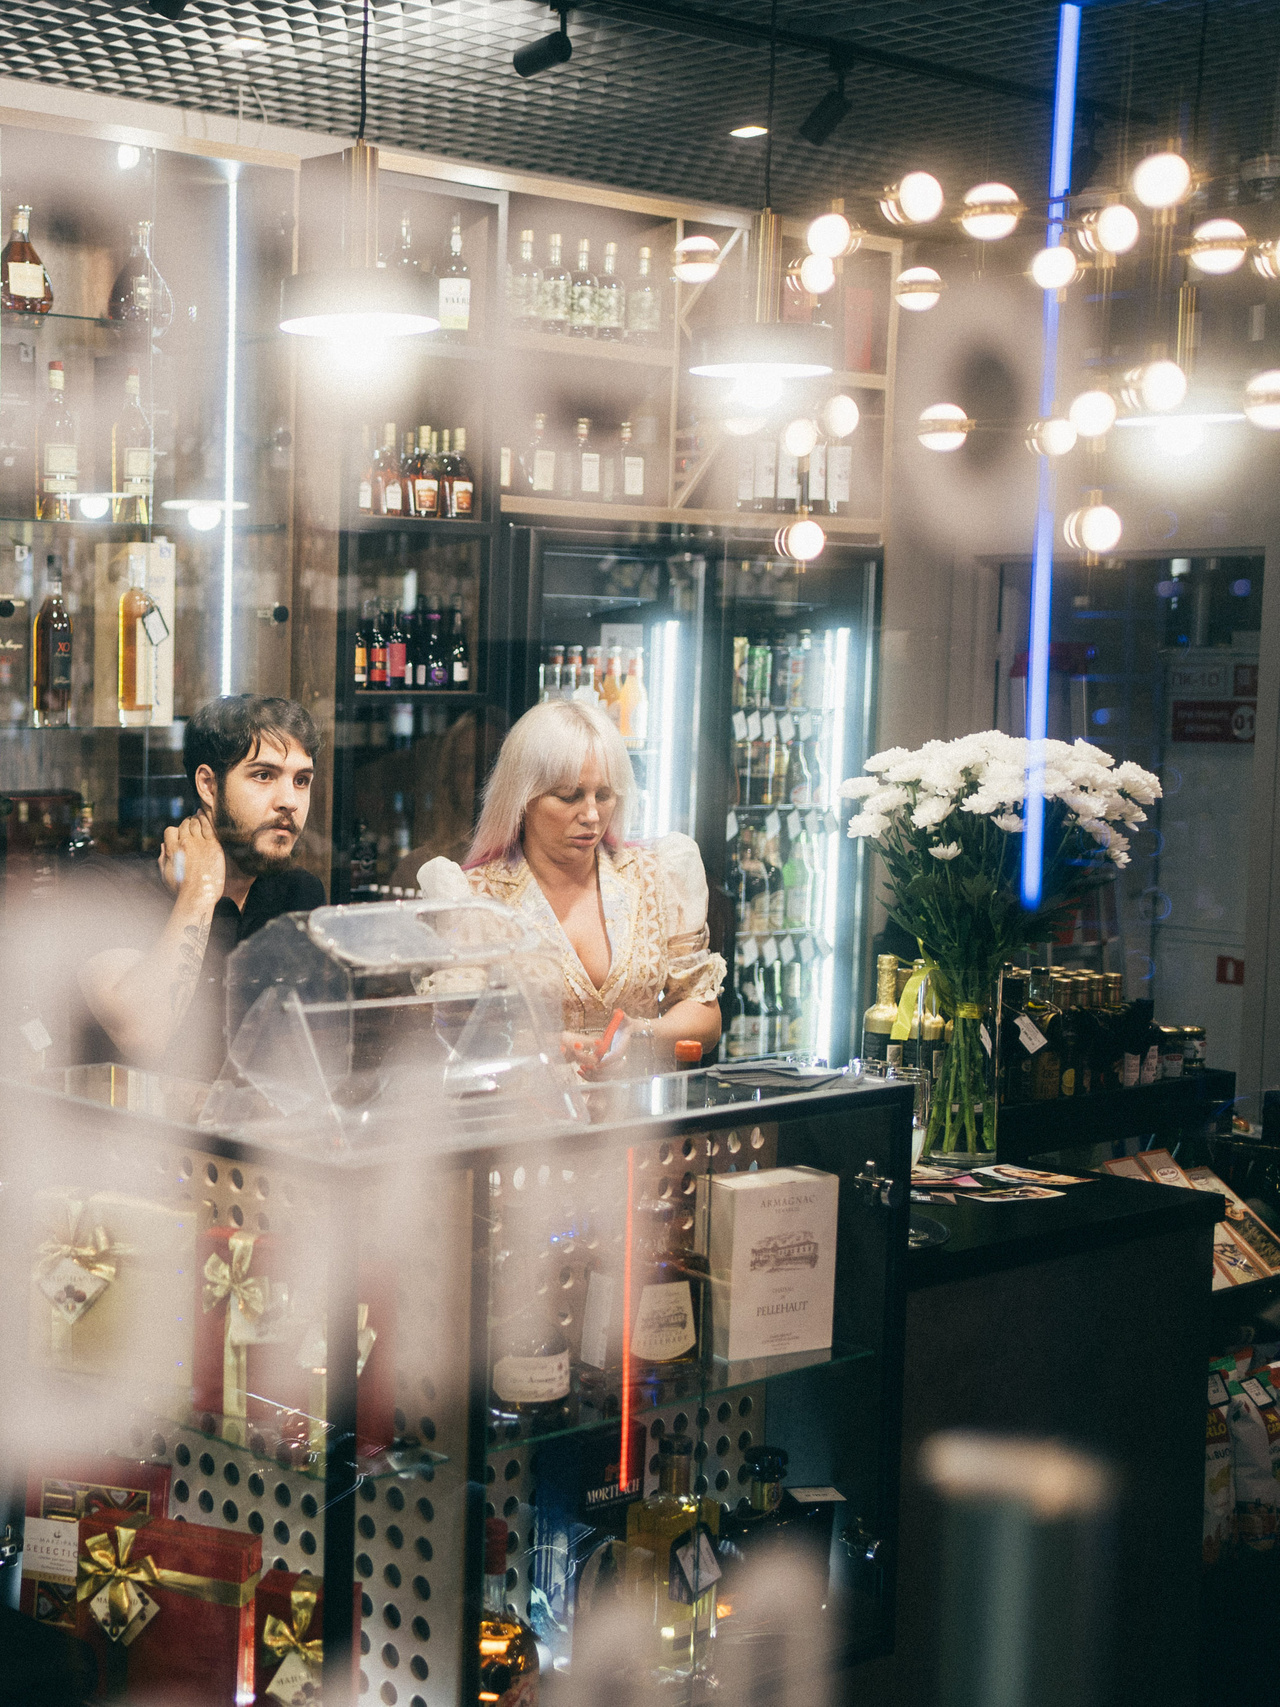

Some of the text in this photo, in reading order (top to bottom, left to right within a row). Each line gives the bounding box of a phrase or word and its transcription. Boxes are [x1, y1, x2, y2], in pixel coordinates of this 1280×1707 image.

[58, 642, 70, 652] XO
[1234, 714, 1254, 730] 01
[761, 1194, 816, 1208] ARMAGNAC
[756, 1300, 809, 1317] PELLEHAUT
